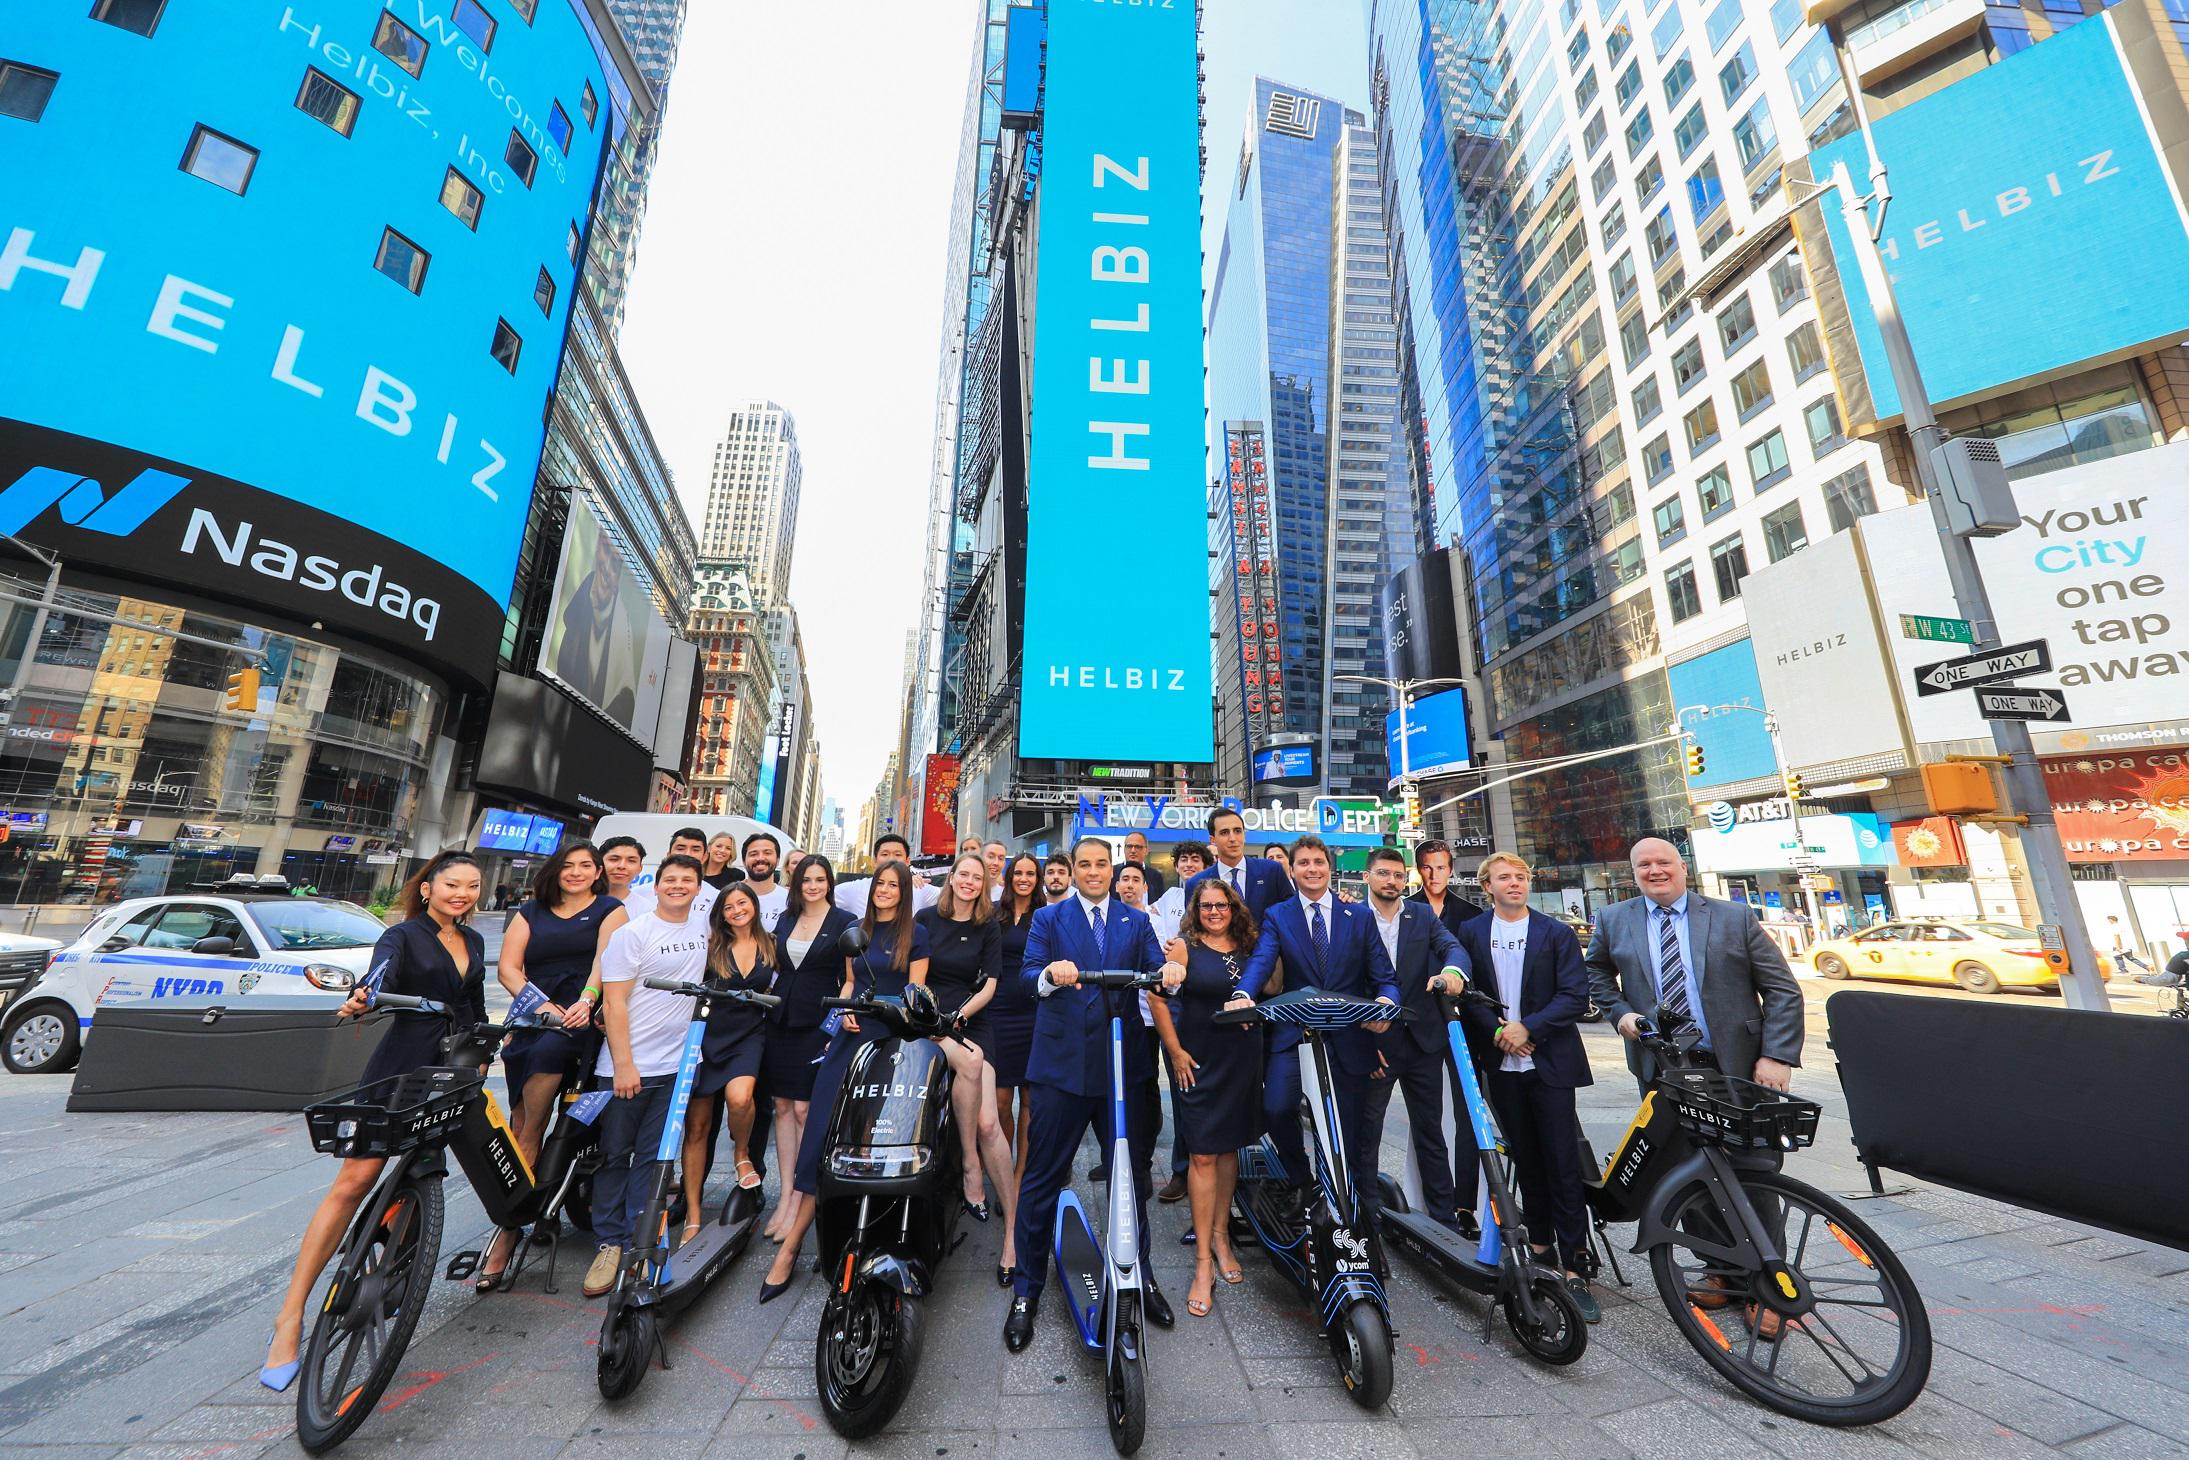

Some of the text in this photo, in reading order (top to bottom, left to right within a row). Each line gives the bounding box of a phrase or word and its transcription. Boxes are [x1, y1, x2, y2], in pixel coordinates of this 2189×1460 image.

[278, 6, 505, 194] Helbiz, Inc
[417, 0, 567, 184] Welcomes
[1087, 154, 1151, 471] HELBIZ
[0, 226, 508, 503] HELBIZ
[2020, 495, 2149, 538] Your
[2034, 535, 2147, 574] City
[179, 507, 442, 641] Nasdaq
[2056, 574, 2165, 609] one
[1918, 619, 1972, 640] W 43 St
[2071, 613, 2171, 645] tap
[1240, 596, 1264, 714] YOUNG
[1776, 633, 1848, 666] HELBIZ
[1049, 665, 1186, 691] HELBIZ
[1934, 652, 2029, 685] ONE WAY
[1991, 696, 2054, 712] ONE WAY
[779, 733, 791, 757] Foot
[2096, 728, 2176, 743] THOMSON
[1078, 794, 1140, 828] NEW
[1144, 795, 1210, 830] YORK
[1318, 800, 1381, 832] DEPT
[1738, 800, 1793, 824] AT&T
[484, 822, 529, 839] HELBIZ
[1447, 877, 1479, 886] HASE
[251, 963, 292, 975] POLICE
[672, 1044, 701, 1132] HELBIZ
[852, 1083, 929, 1100] HELBIZ
[411, 1104, 465, 1132] HELBIZ
[870, 1126, 894, 1135] Electric
[1679, 1104, 1732, 1129] HELBIZ
[488, 1138, 519, 1188] HELBIZ
[1619, 1138, 1650, 1186] HELBIZ
[1119, 1167, 1132, 1244] HELBIZ
[1304, 1207, 1320, 1292] HELBIZ
[1082, 1272, 1099, 1300] HELBIZ
